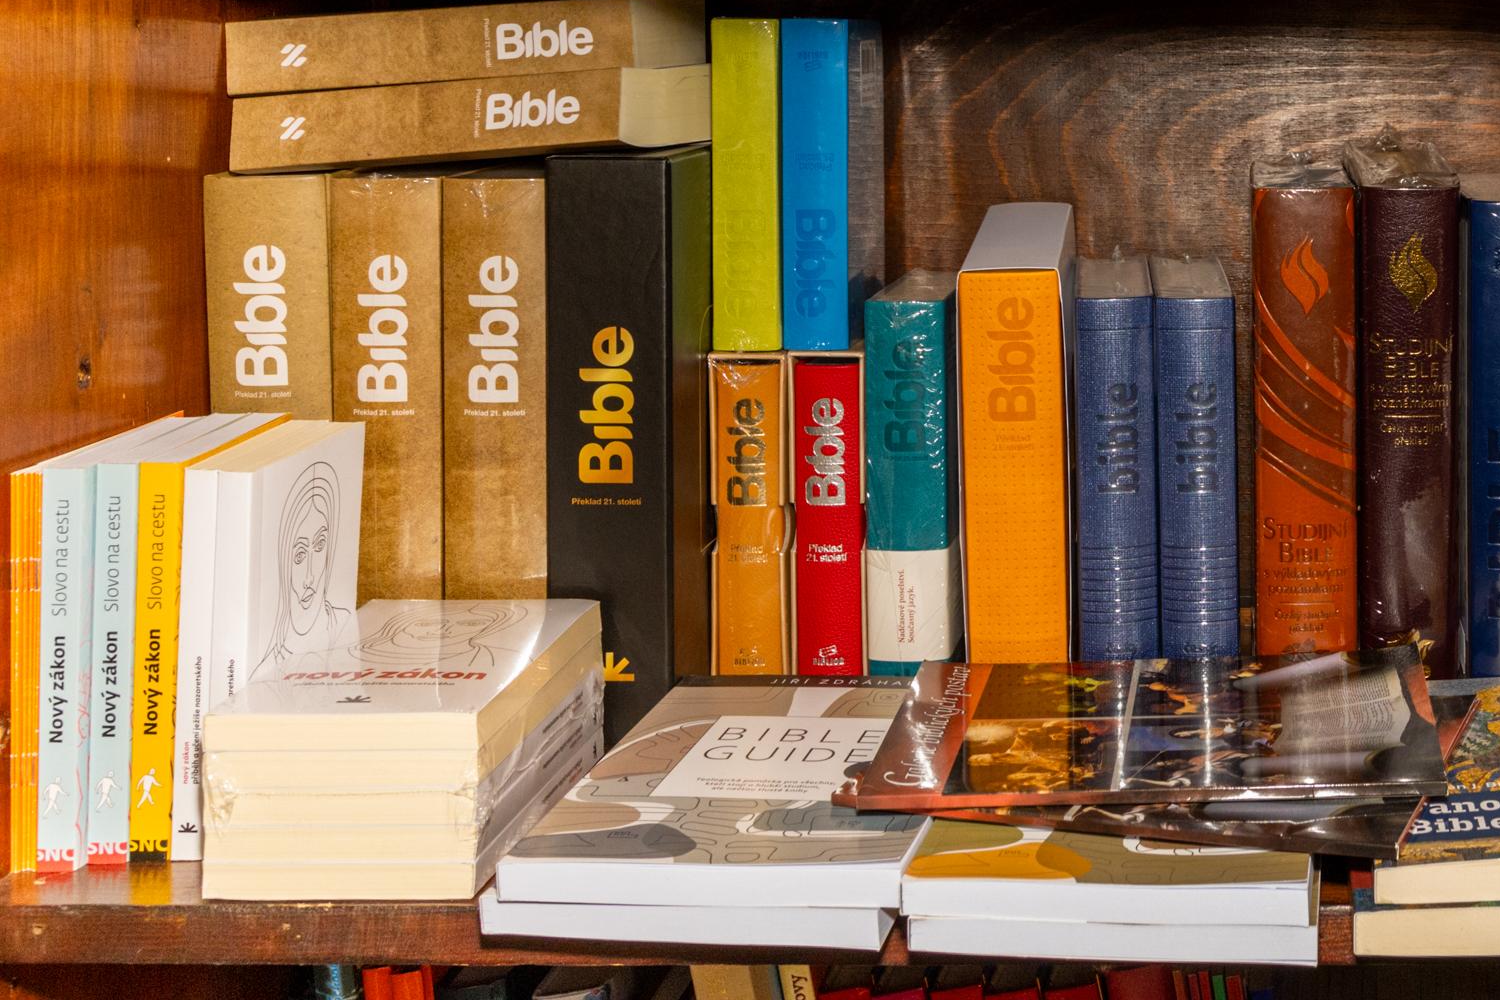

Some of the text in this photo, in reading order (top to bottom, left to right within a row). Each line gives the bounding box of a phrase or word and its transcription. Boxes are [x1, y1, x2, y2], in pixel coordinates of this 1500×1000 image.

[496, 19, 594, 60] Bible
[485, 88, 580, 130] Bible
[233, 244, 288, 387] Bible
[357, 254, 409, 403] Bible
[468, 254, 520, 404] Bible
[988, 296, 1037, 423] Bible
[353, 407, 415, 417] Překlad 21. století
[463, 407, 526, 417] Překlad 21. století
[578, 326, 635, 484] Bible
[726, 397, 767, 507] Bible
[804, 397, 846, 506] Bible
[1096, 381, 1140, 494] bible
[1175, 381, 1219, 494] bible
[571, 496, 642, 506] Překlad 21. století
[808, 543, 843, 553] Překlad
[806, 552, 848, 563] 21. století
[49, 499, 70, 744] Nový zákon Slovo na cestu
[101, 495, 121, 738] Nový zákon Slovo na cestu
[144, 493, 166, 736] Nový zákon Slovo na cestu
[283, 667, 488, 682] nový zákon
[703, 746, 873, 763] GUIDE
[718, 727, 886, 745] BIBLE
